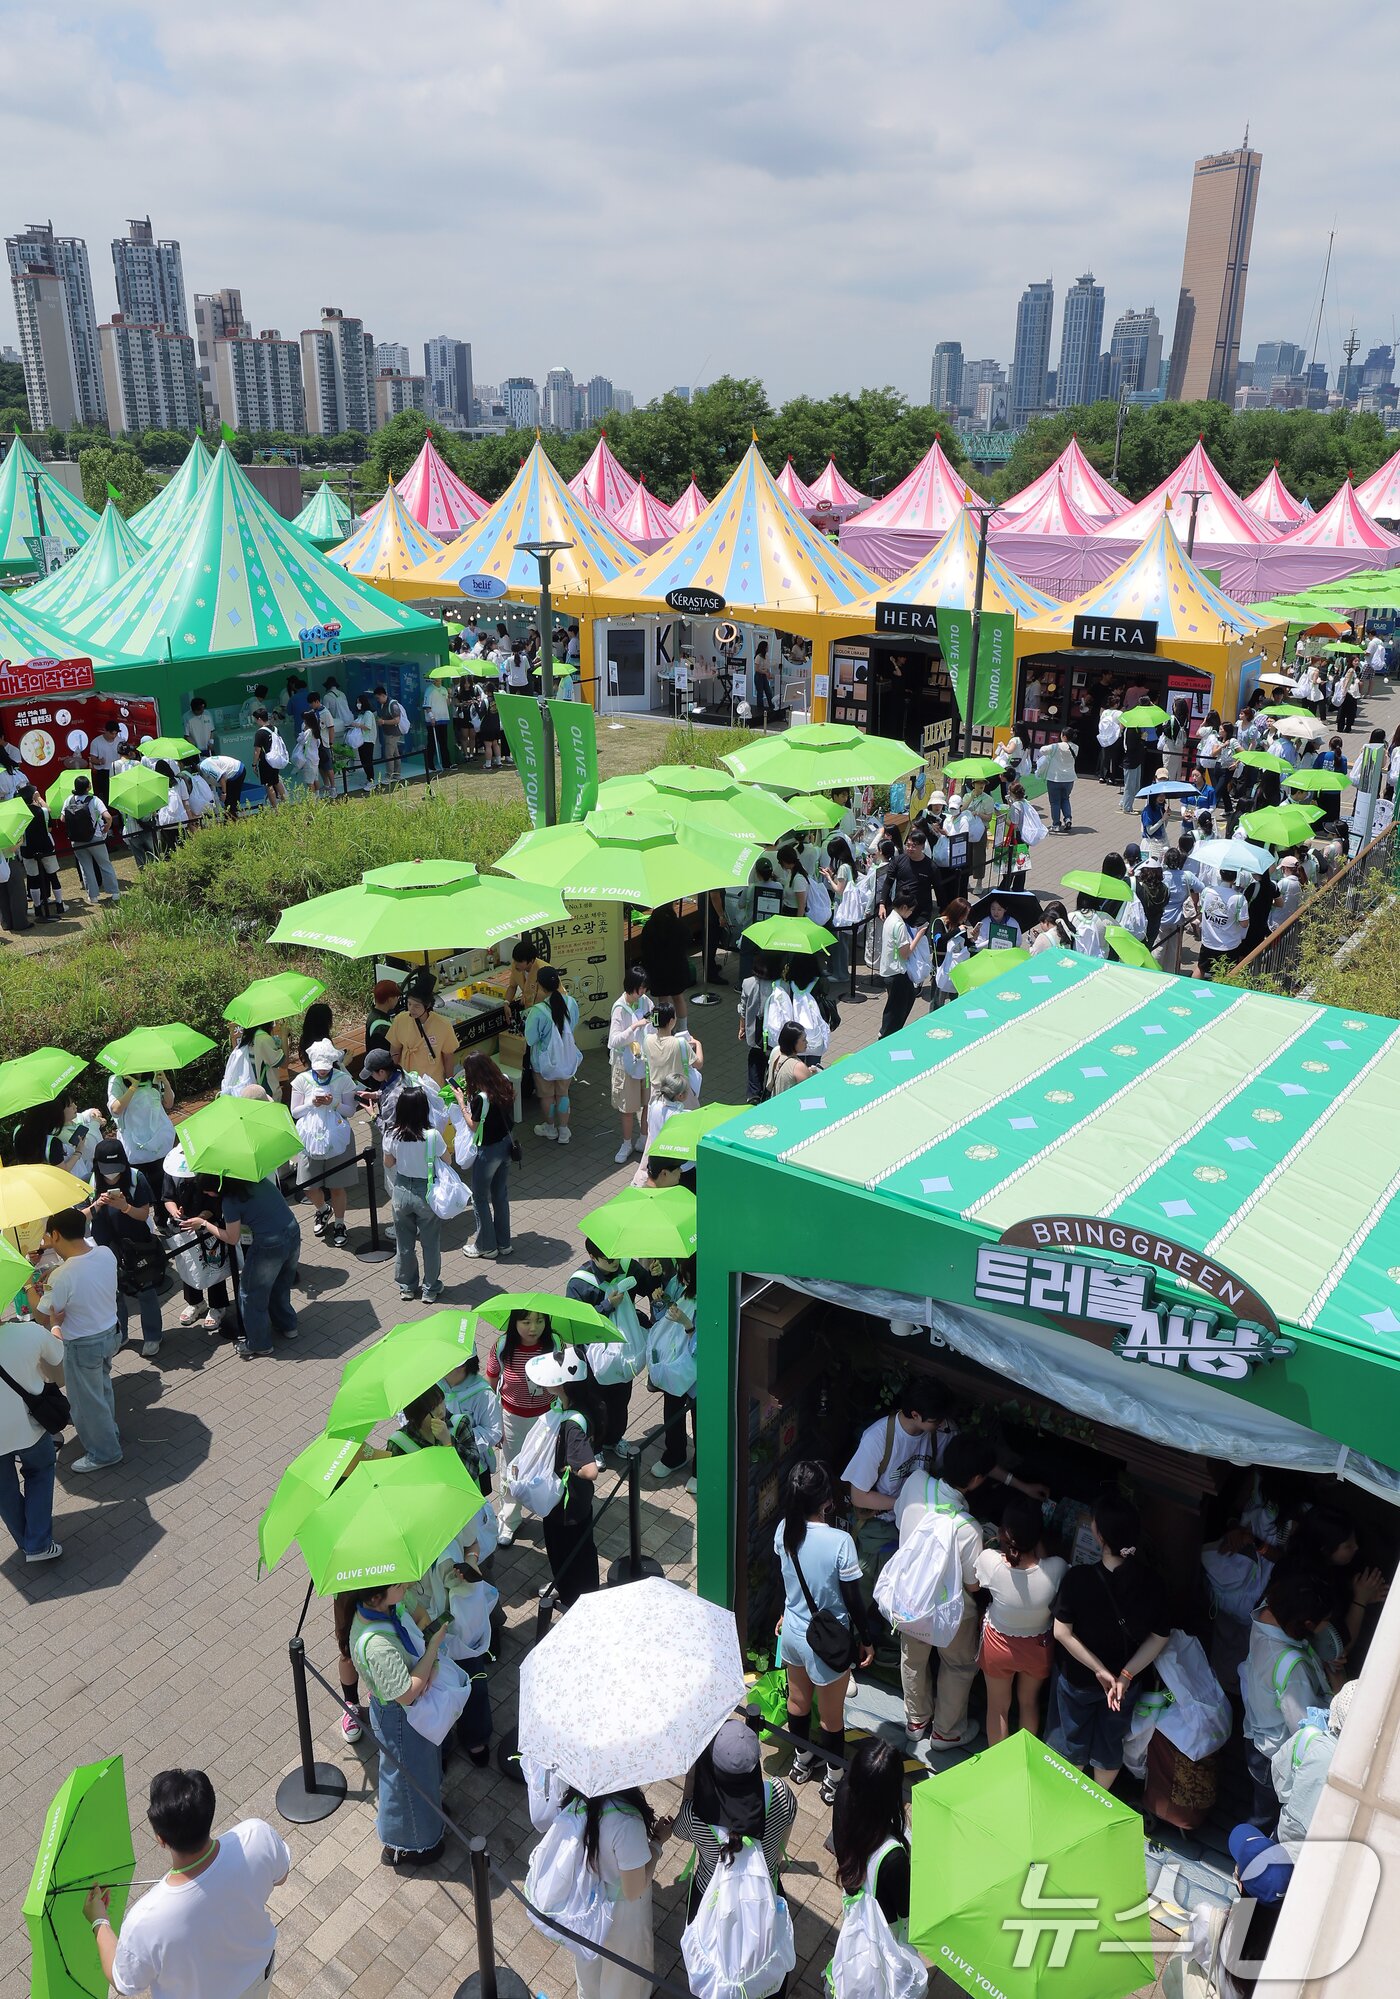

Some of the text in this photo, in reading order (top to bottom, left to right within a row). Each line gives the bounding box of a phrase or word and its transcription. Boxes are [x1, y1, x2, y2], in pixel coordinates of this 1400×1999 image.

[472, 579, 492, 590] belif
[670, 592, 719, 609] KÉRASTASE
[884, 610, 937, 629] HERA
[1082, 625, 1144, 645] HERA
[301, 638, 341, 659] Dr.G
[950, 624, 960, 694] OLIVE YOU
[44, 665, 93, 690] 작업실
[988, 628, 1003, 710] OLIVE YOUNG
[222, 736, 239, 744] Brand
[517, 717, 537, 768] OLIVE
[570, 725, 587, 778] OLIVE
[816, 775, 876, 787] OLIVE YOUNG
[731, 847, 753, 876] OLIVE YOUNG
[564, 886, 641, 898] OLIVE YOUNG
[485, 911, 549, 937] OLIVE YOUNG
[544, 921, 596, 939] 피부 오광
[1204, 911, 1228, 926] VANS
[291, 930, 357, 948] OLIVE YOUNG
[1031, 1221, 1244, 1306] BRINGGREEN
[975, 1248, 1146, 1325] 트러블
[323, 1435, 356, 1482] OLIVE YOUNG
[336, 1563, 396, 1581] OLIVE YOUNG
[1043, 1754, 1113, 1809] OLIVE YOUNG
[36, 1806, 61, 1891] OLIVE YOUNG
[940, 1945, 1008, 1999] OLIVE YOUN
